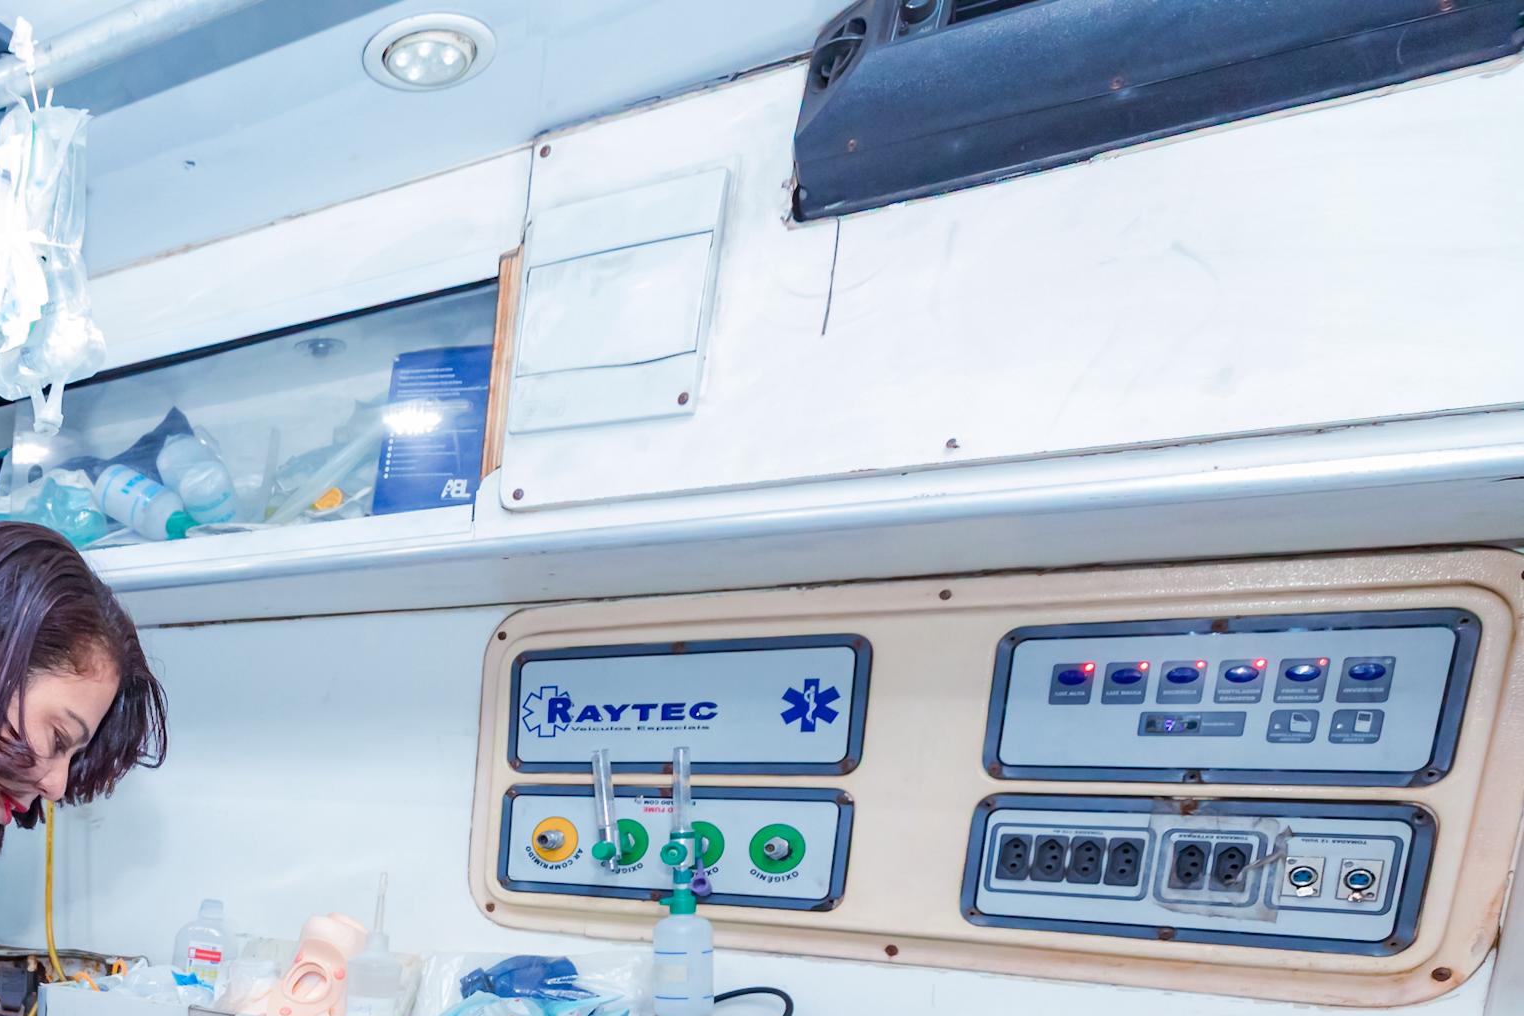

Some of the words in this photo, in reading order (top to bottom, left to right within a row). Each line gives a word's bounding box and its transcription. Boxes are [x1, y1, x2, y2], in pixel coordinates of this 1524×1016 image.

[547, 697, 718, 723] RAYTEC
[525, 846, 574, 870] COMPRIMIDO
[574, 848, 584, 860] AR
[600, 861, 644, 875] OXIGO
